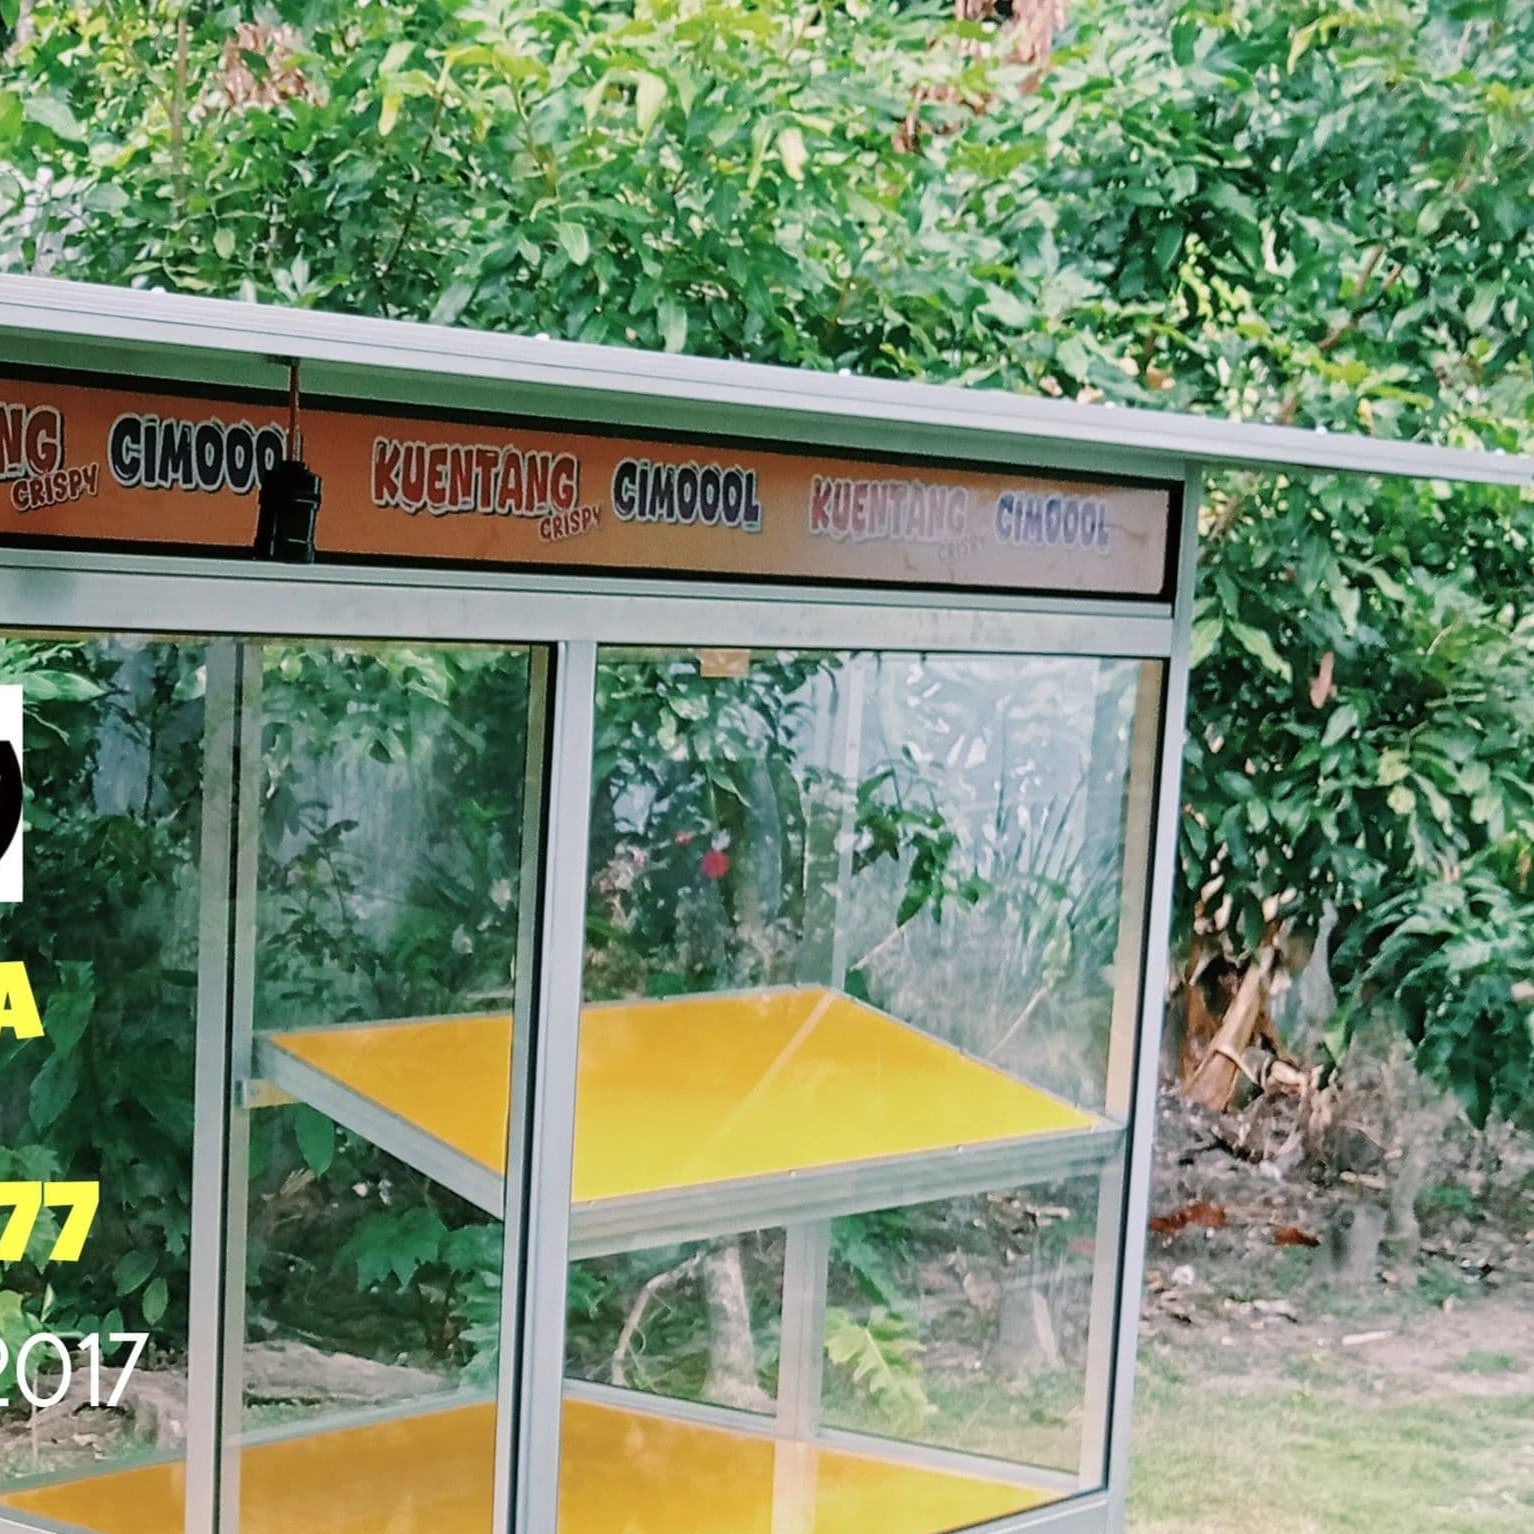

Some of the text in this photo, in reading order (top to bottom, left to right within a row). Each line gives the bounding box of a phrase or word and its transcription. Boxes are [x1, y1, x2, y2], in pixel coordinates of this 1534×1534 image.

[11, 463, 100, 509] CRISPY
[111, 415, 302, 491] CIMOOO
[372, 438, 762, 527] KUENTANG CIMOOOL
[539, 504, 603, 541] CRISPY
[810, 478, 1112, 548] KUENTANG CIMOOOL
